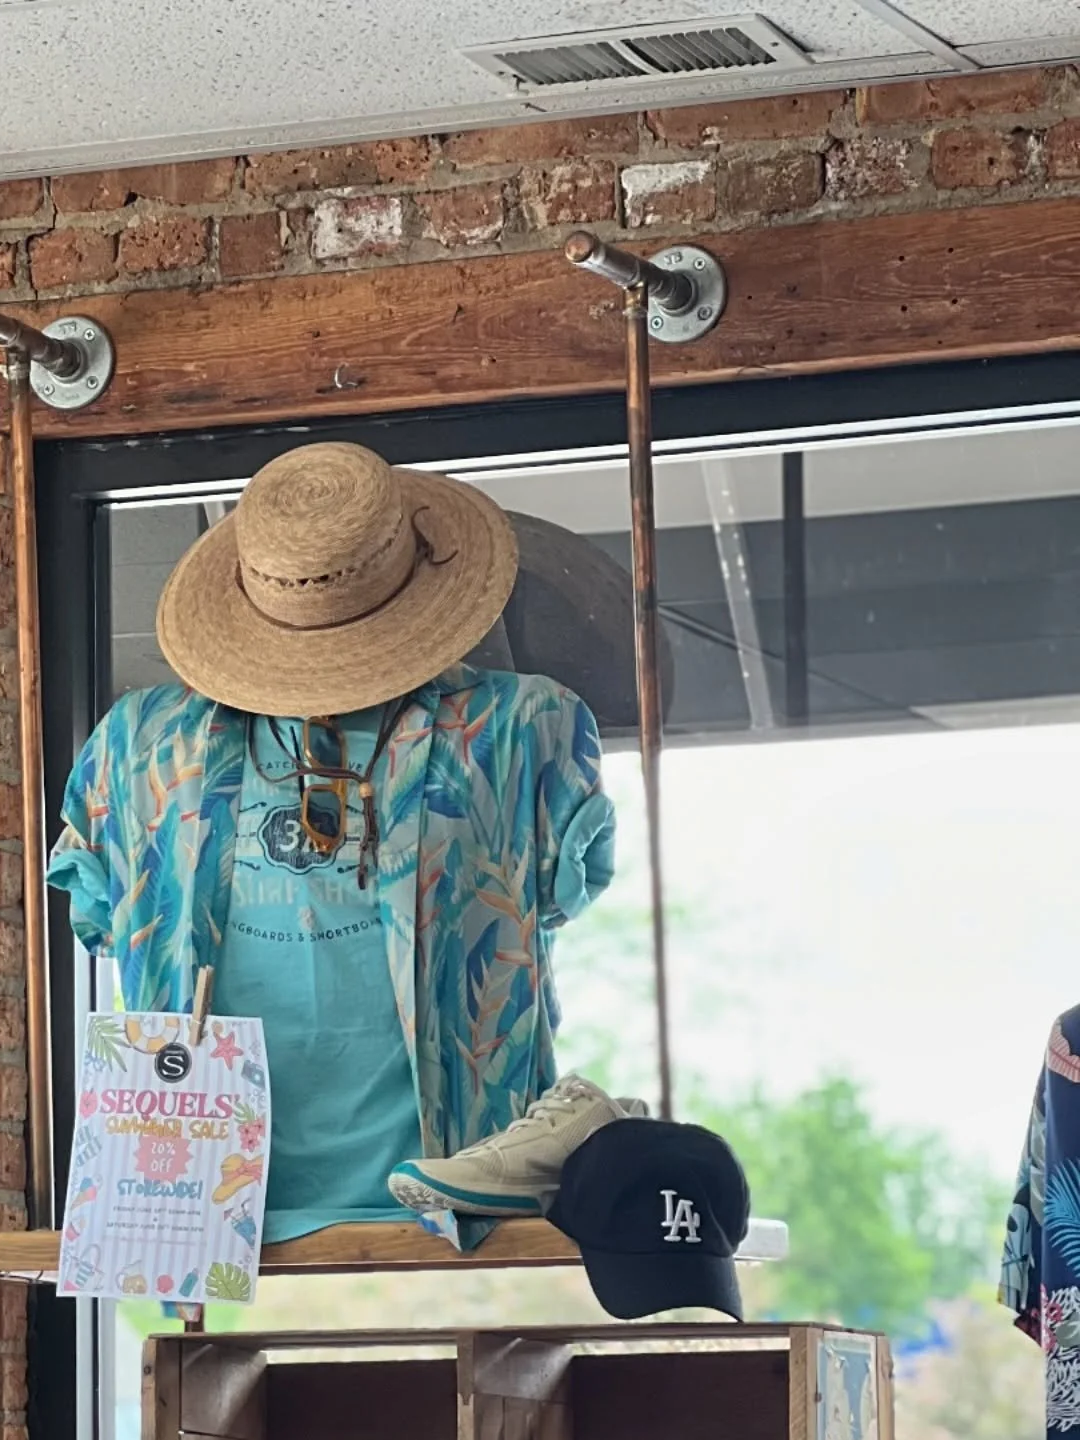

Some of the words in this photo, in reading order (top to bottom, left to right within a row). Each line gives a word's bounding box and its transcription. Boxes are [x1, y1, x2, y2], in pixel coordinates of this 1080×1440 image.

[162, 1055, 185, 1077] S
[105, 1115, 182, 1138] SUMMER
[189, 1119, 229, 1140] SALE
[151, 1142, 176, 1156] 20%
[150, 1158, 173, 1173] OFF
[660, 1189, 703, 1244] LA
